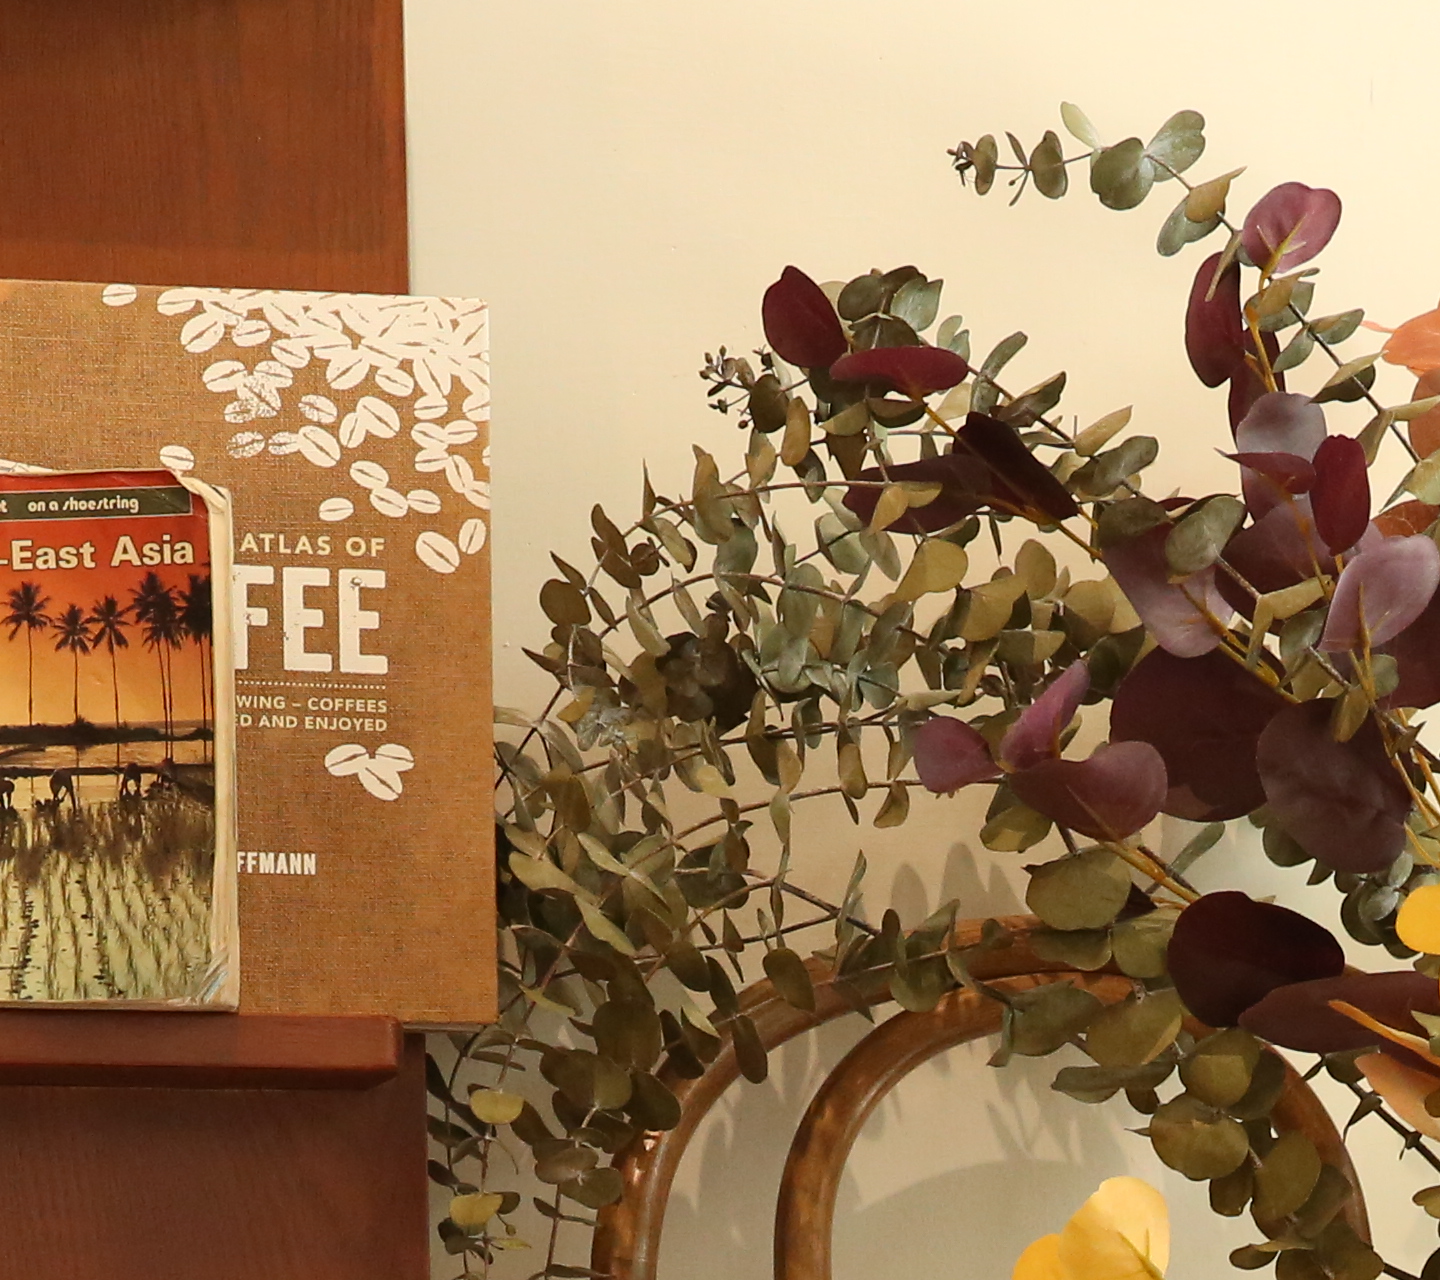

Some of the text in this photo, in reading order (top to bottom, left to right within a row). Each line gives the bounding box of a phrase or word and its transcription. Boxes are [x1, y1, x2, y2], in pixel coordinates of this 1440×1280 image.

[28, 501, 45, 512] on
[49, 500, 59, 511] a
[62, 495, 139, 513] shoestring
[110, 534, 195, 568] Asia
[239, 532, 385, 558] ATLAS OF
[307, 697, 388, 713] COFFEES
[259, 715, 298, 728] AND
[304, 716, 388, 732] ENJOYED
